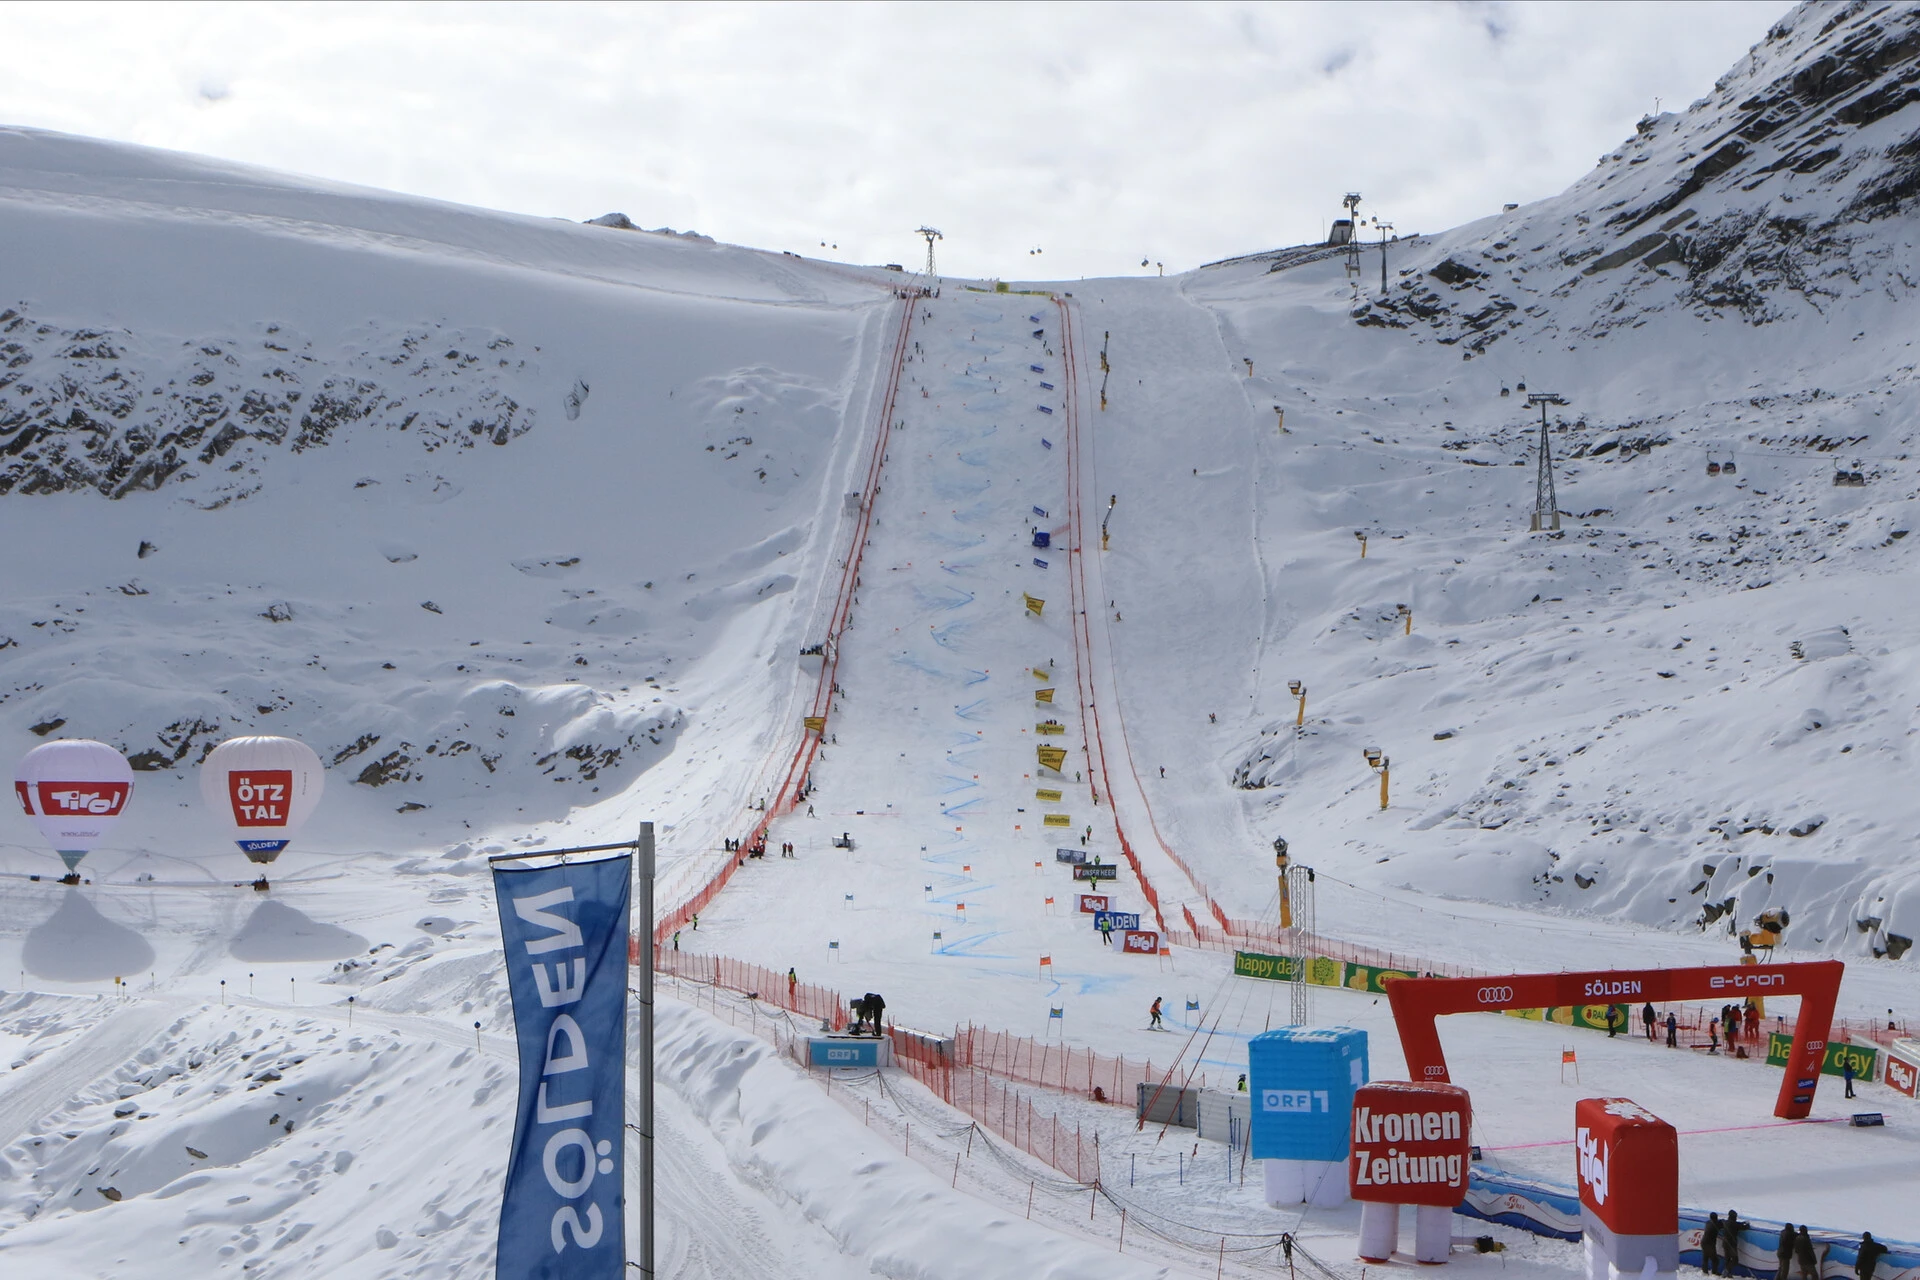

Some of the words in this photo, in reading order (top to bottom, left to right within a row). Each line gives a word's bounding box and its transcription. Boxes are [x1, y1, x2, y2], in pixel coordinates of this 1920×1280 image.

[237, 777, 284, 802] ÖTZ
[51, 790, 120, 814] Tirol
[239, 805, 282, 820] TAL
[1100, 869, 1116, 877] HEER
[1083, 898, 1105, 912] Tirol
[1128, 934, 1154, 951] Tirol
[1236, 952, 1274, 978] happy
[1584, 979, 1642, 997] SÖLDEN
[1710, 974, 1785, 988] e-tron
[1889, 1061, 1913, 1089] Tirol
[1355, 1107, 1461, 1143] Kronen
[1355, 1148, 1462, 1187] Zeitung
[1577, 1127, 1609, 1206] Tirol
